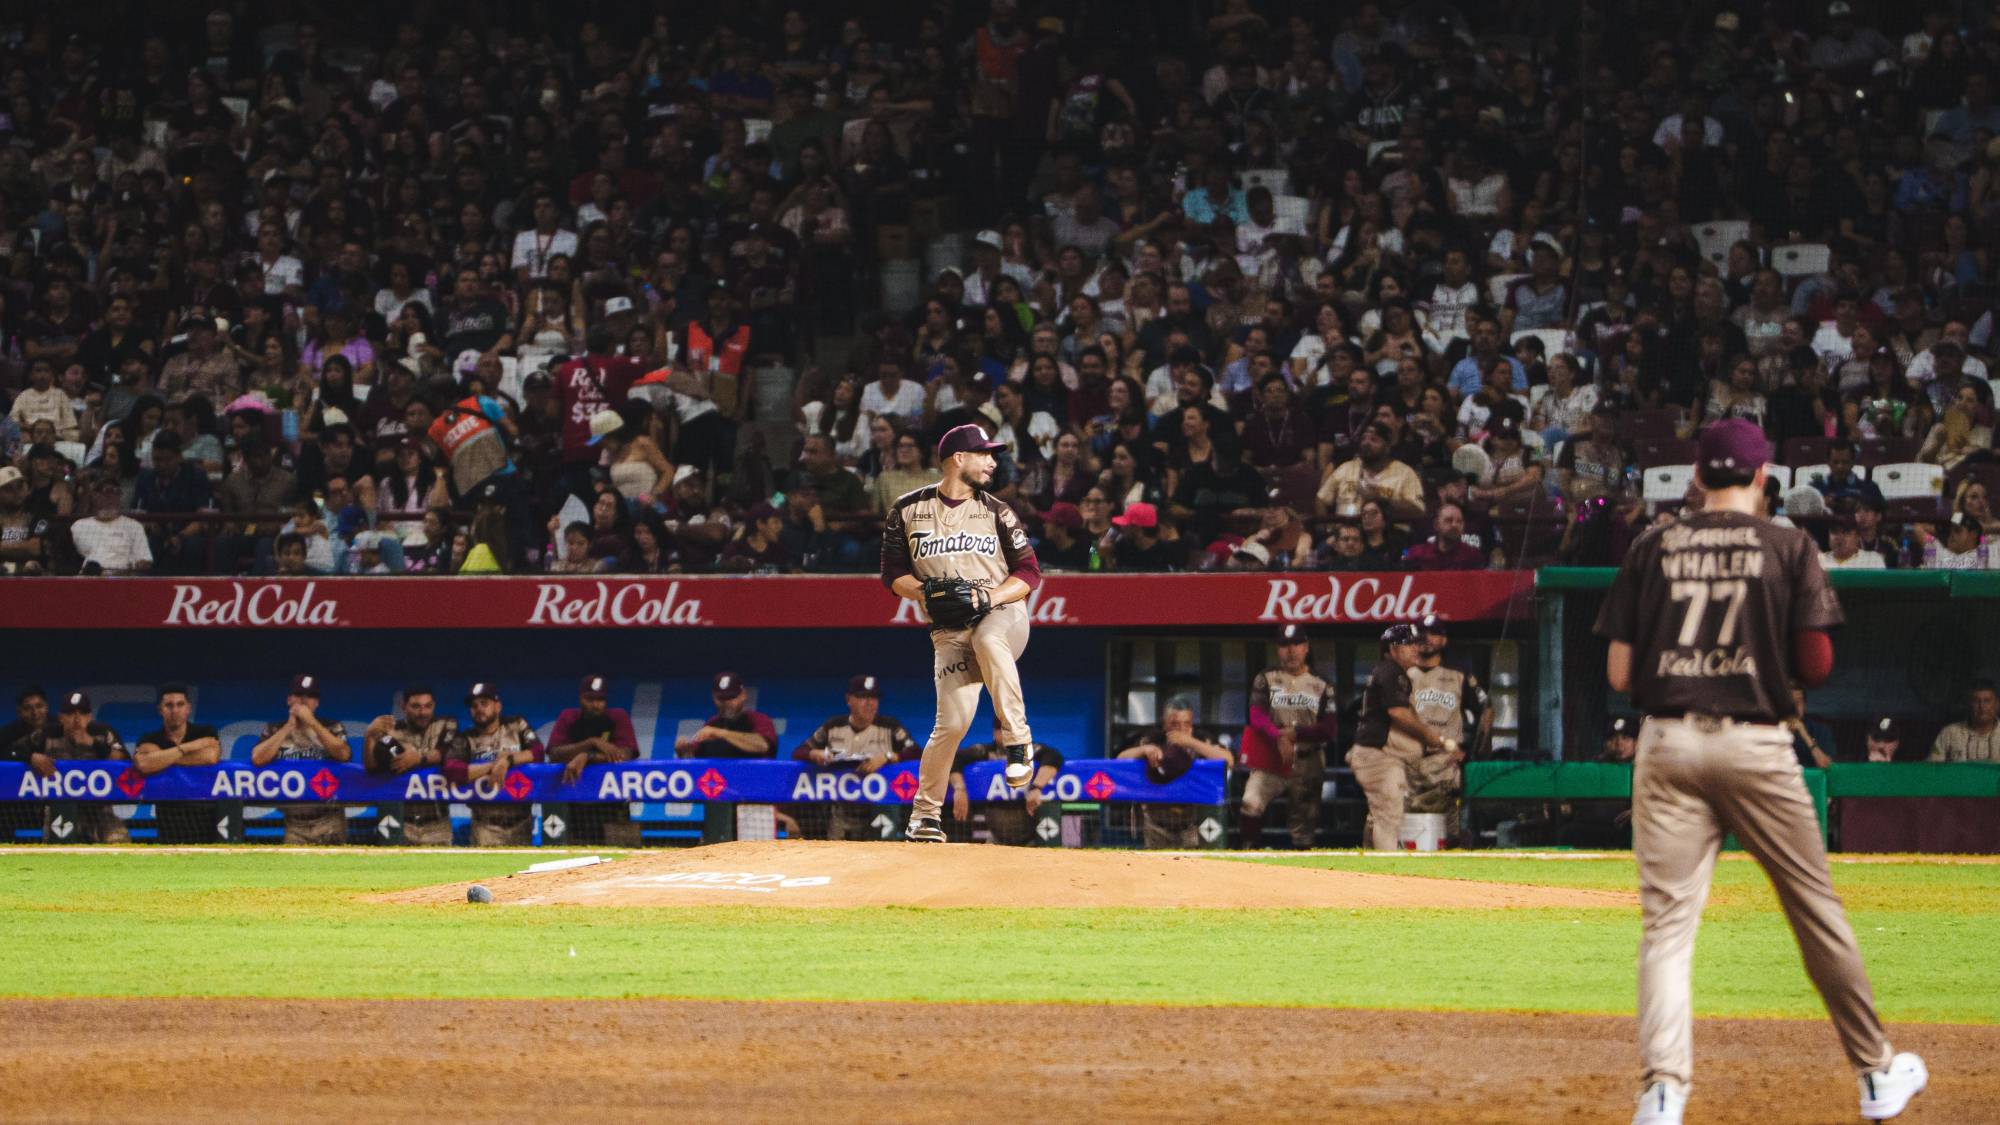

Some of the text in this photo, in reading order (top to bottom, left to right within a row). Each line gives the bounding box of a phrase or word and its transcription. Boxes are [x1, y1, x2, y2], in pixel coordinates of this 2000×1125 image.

[909, 530, 999, 561] Tomateros
[1661, 550, 1764, 578] WHALEN
[1670, 580, 1748, 646] 77
[18, 769, 112, 797] ARCO
[211, 770, 305, 798] ARCO
[598, 770, 693, 798] ARCO
[792, 772, 888, 801] ARCO
